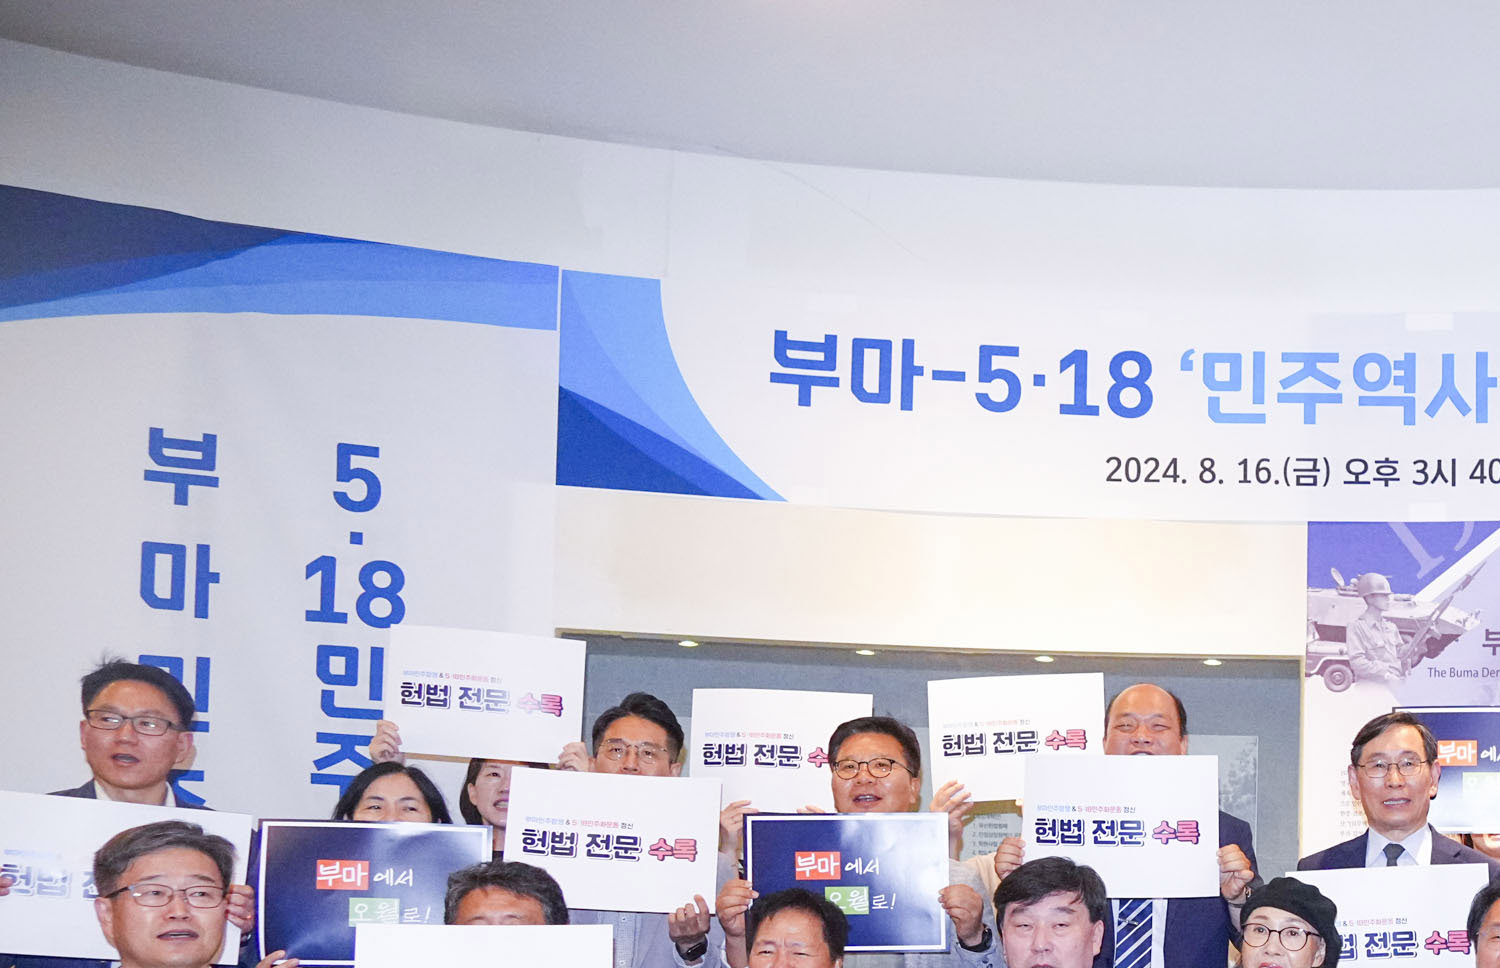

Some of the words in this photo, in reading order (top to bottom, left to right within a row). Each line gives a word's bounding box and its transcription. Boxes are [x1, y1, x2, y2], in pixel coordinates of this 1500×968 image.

[770, 329, 1153, 419] 부마-5·18
[1105, 456, 1187, 484] 2024.
[1198, 457, 1224, 484] 8.
[1237, 456, 1331, 488] 16.(금)
[1342, 457, 1400, 487] 오후
[1412, 457, 1457, 487] 3시
[1427, 667, 1447, 678] The
[1449, 667, 1479, 678] Buma
[400, 681, 451, 709] 헌법
[458, 685, 510, 713] 전문
[516, 693, 564, 717] 수록
[702, 741, 750, 767] 헌법
[753, 743, 803, 768] 전문
[807, 745, 828, 767] 수
[942, 731, 986, 757] 헌법
[992, 729, 1039, 754] 전문
[1045, 728, 1088, 751] 수록
[522, 828, 578, 858] 헌법
[585, 832, 642, 861] 전문
[648, 837, 698, 862] 수록
[1034, 818, 1085, 845] 헌법
[1091, 819, 1146, 847] 전문
[1152, 819, 1200, 845] 수록
[1365, 930, 1418, 958] 전문
[1424, 930, 1471, 955] 수록
